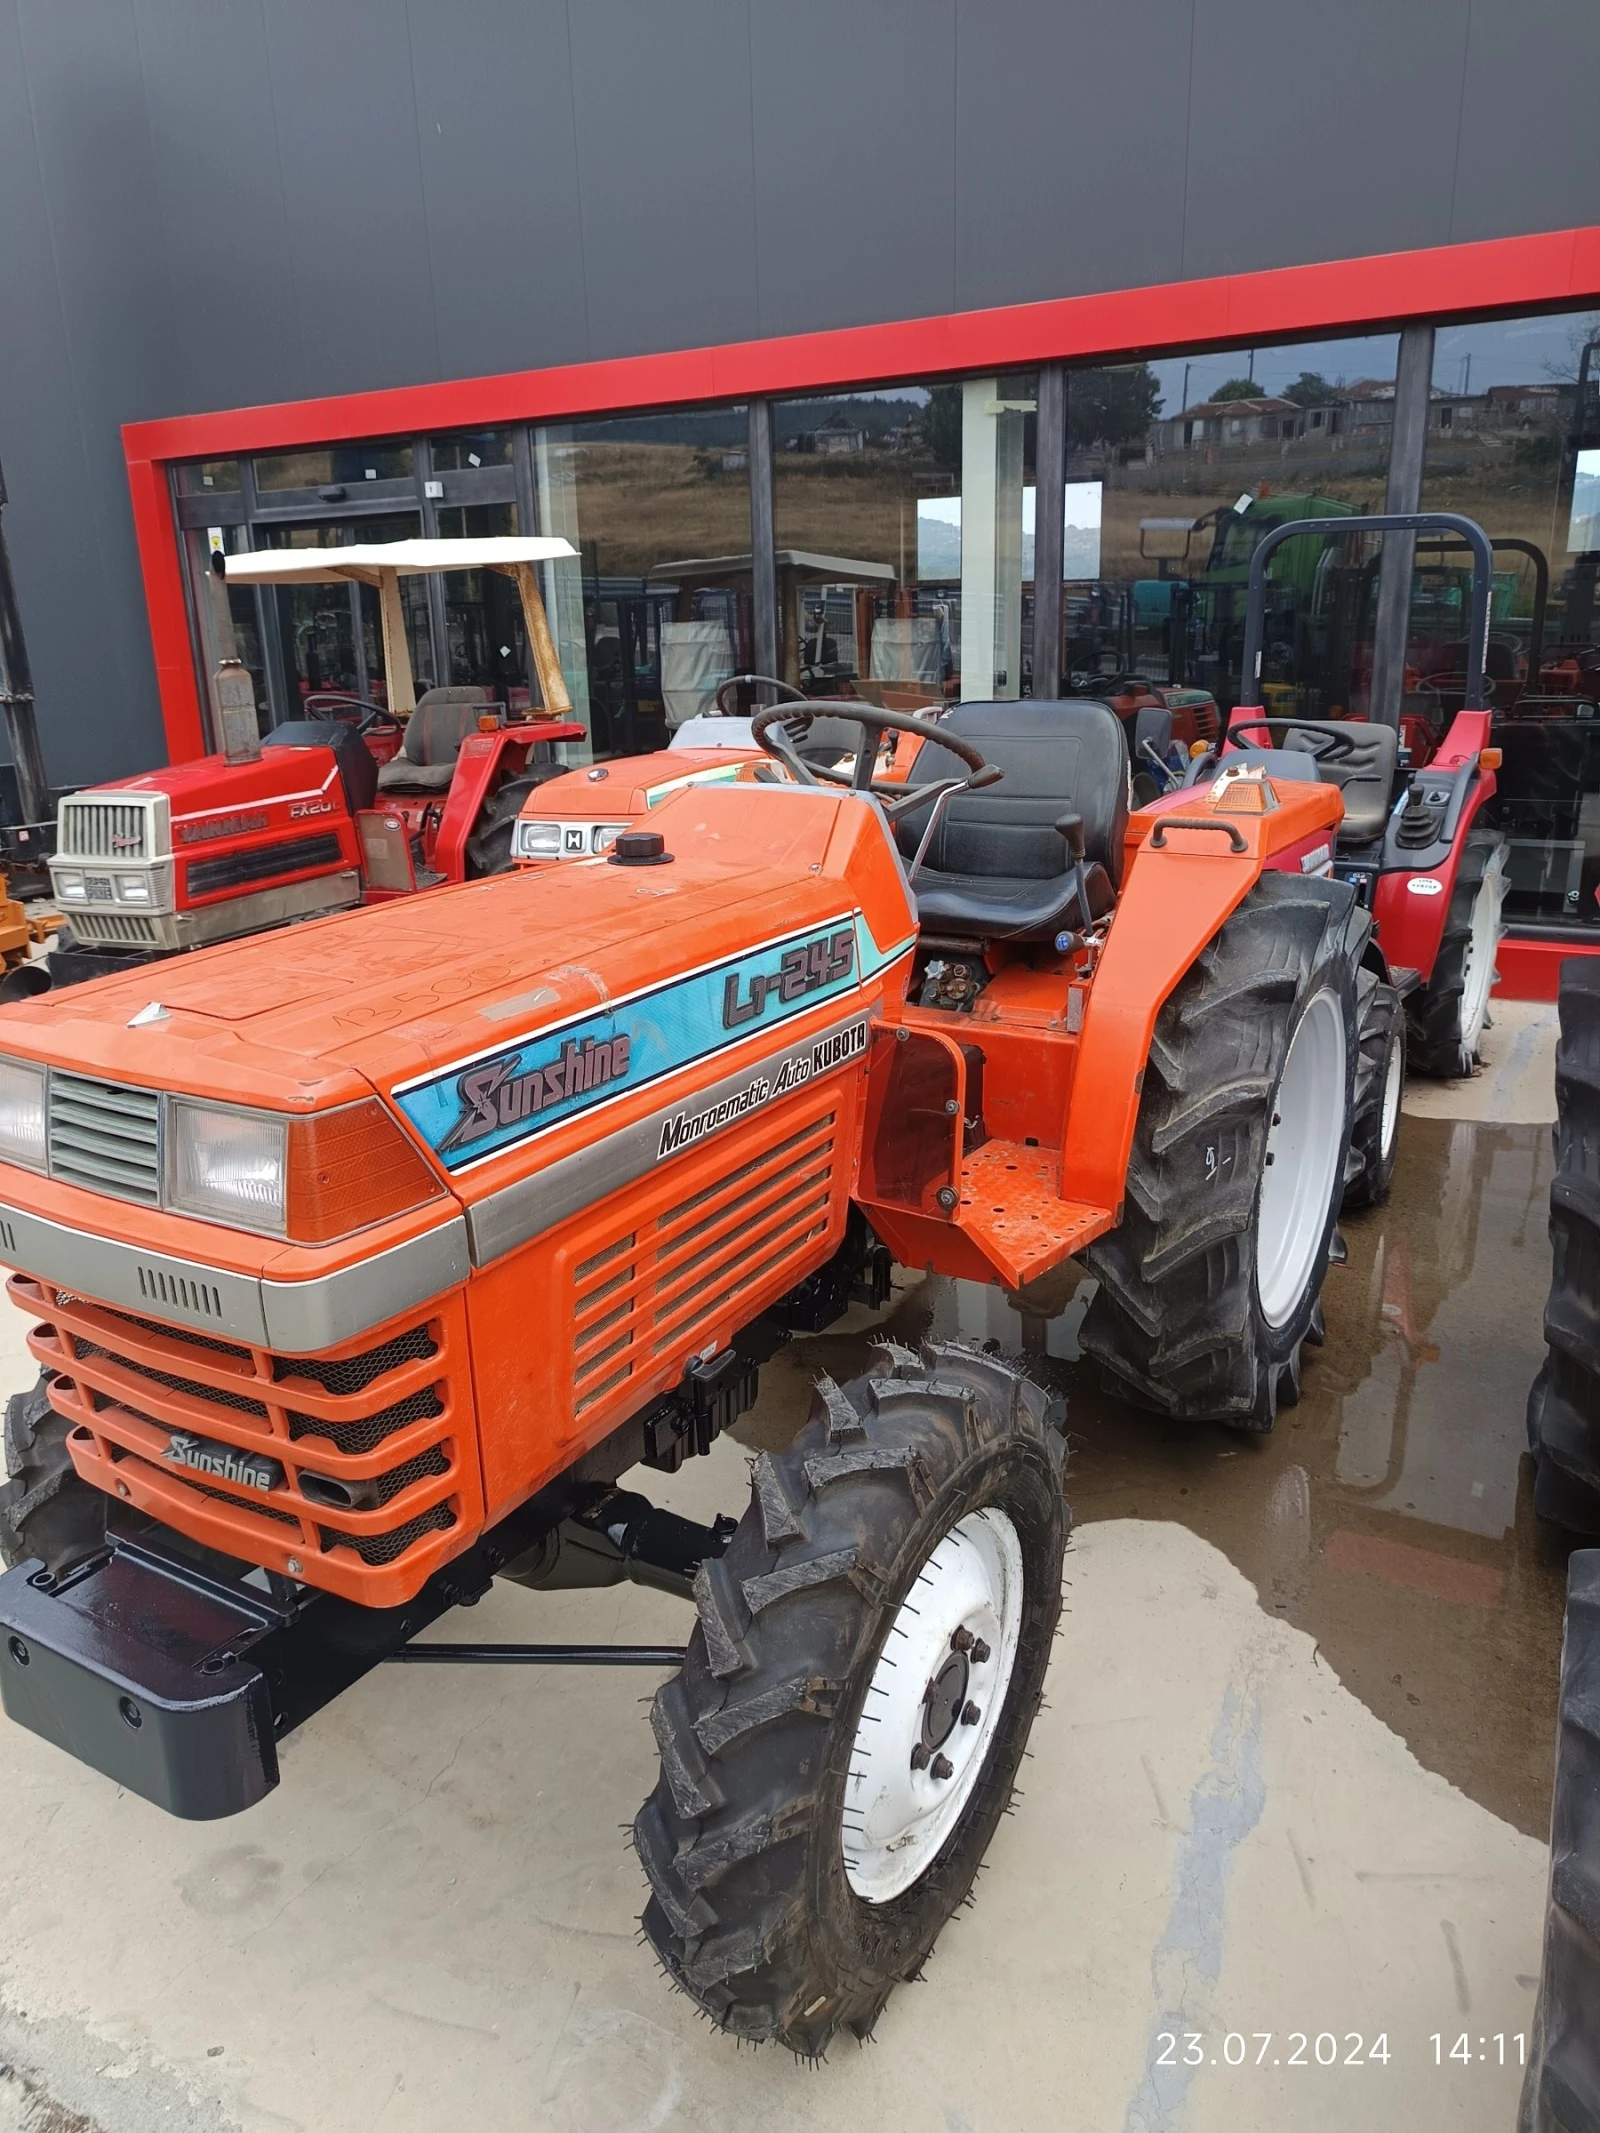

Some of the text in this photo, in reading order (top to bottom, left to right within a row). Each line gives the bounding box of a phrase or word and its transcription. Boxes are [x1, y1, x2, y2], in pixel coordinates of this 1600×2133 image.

[438, 1033, 630, 1154] Sunshine
[657, 1021, 866, 1160] Monroematic Auto KUBOTA
[160, 1435, 271, 1492] Sunshine
